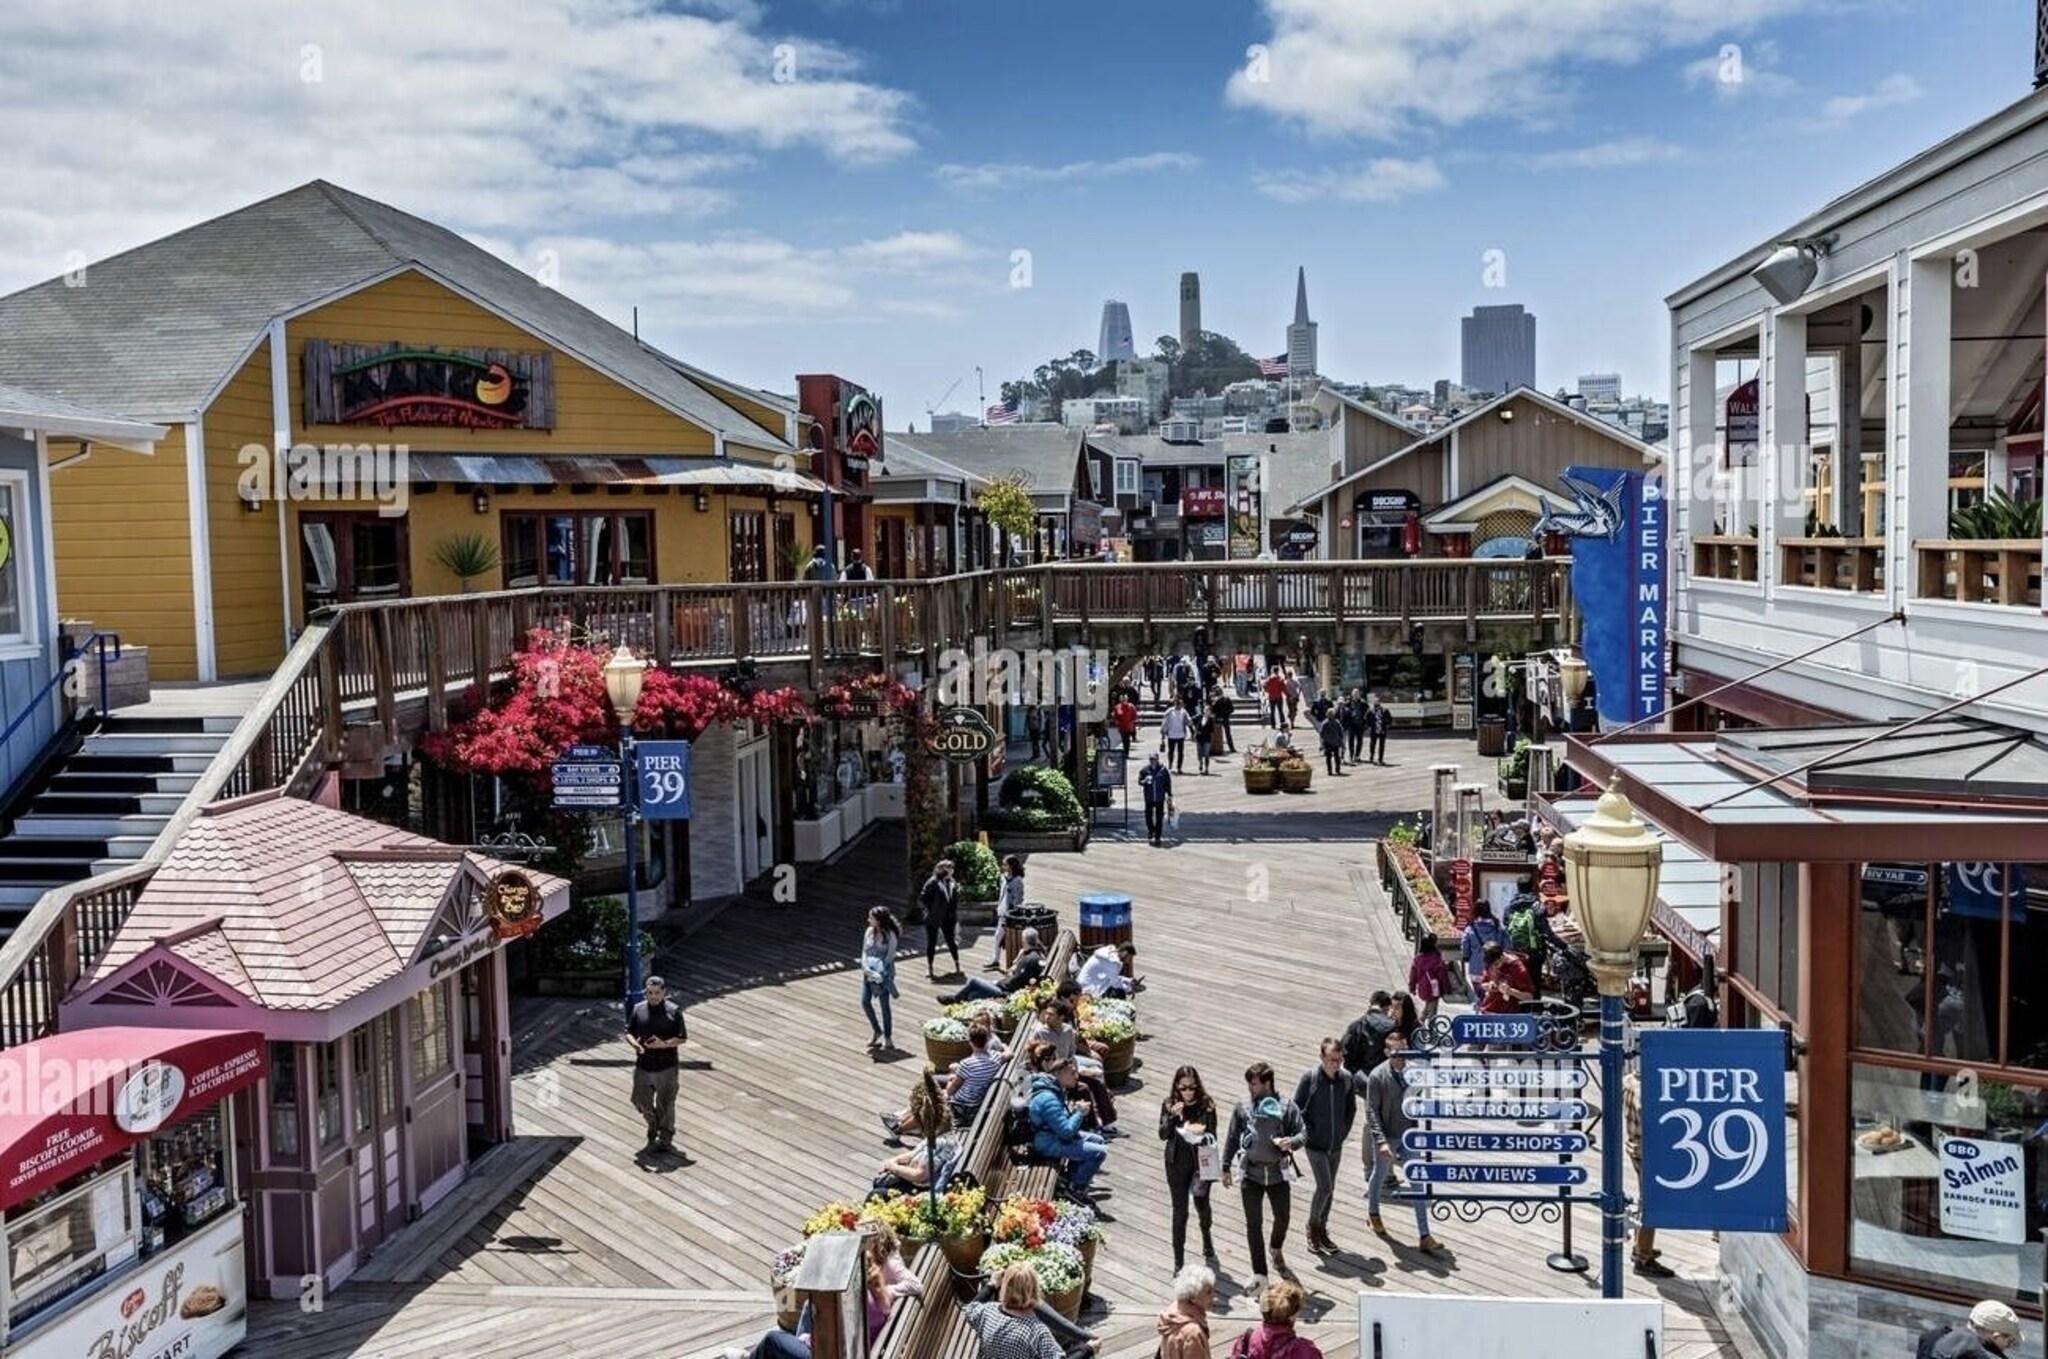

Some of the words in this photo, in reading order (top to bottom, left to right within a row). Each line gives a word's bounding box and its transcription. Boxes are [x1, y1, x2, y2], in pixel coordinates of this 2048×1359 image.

[1641, 485, 1659, 570] PIER
[1639, 584, 1660, 714] MARKET
[933, 734, 988, 750] GOLD
[644, 756, 682, 770] PIER
[643, 771, 685, 804] 39
[1463, 1022, 1505, 1038] PIER
[1507, 1022, 1529, 1038] 39
[191, 1067, 219, 1086] COFFEE
[1437, 1072, 1490, 1085] SWISS
[1495, 1072, 1544, 1085] LOUIS
[1658, 1067, 1763, 1103] PIER
[188, 1084, 208, 1098] ICED
[1444, 1104, 1549, 1118] RESTROOMS
[46, 1128, 70, 1147] FREE
[1436, 1135, 1487, 1149] LEVEL
[1491, 1135, 1501, 1149] 2
[1505, 1136, 1563, 1150] SHOPS
[19, 1145, 60, 1173] BISCOFF
[60, 1127, 96, 1151] COOKIE
[1654, 1108, 1770, 1192] 39
[1948, 1143, 1977, 1156] BBQ
[10, 1167, 37, 1188] SERVED
[37, 1158, 58, 1173] WITH
[57, 1148, 79, 1163] EVERY
[1446, 1167, 1479, 1181] BAY
[1482, 1167, 1537, 1181] VIEWS
[1944, 1156, 2019, 1189] Salmon
[86, 1262, 184, 1359] Biscoff
